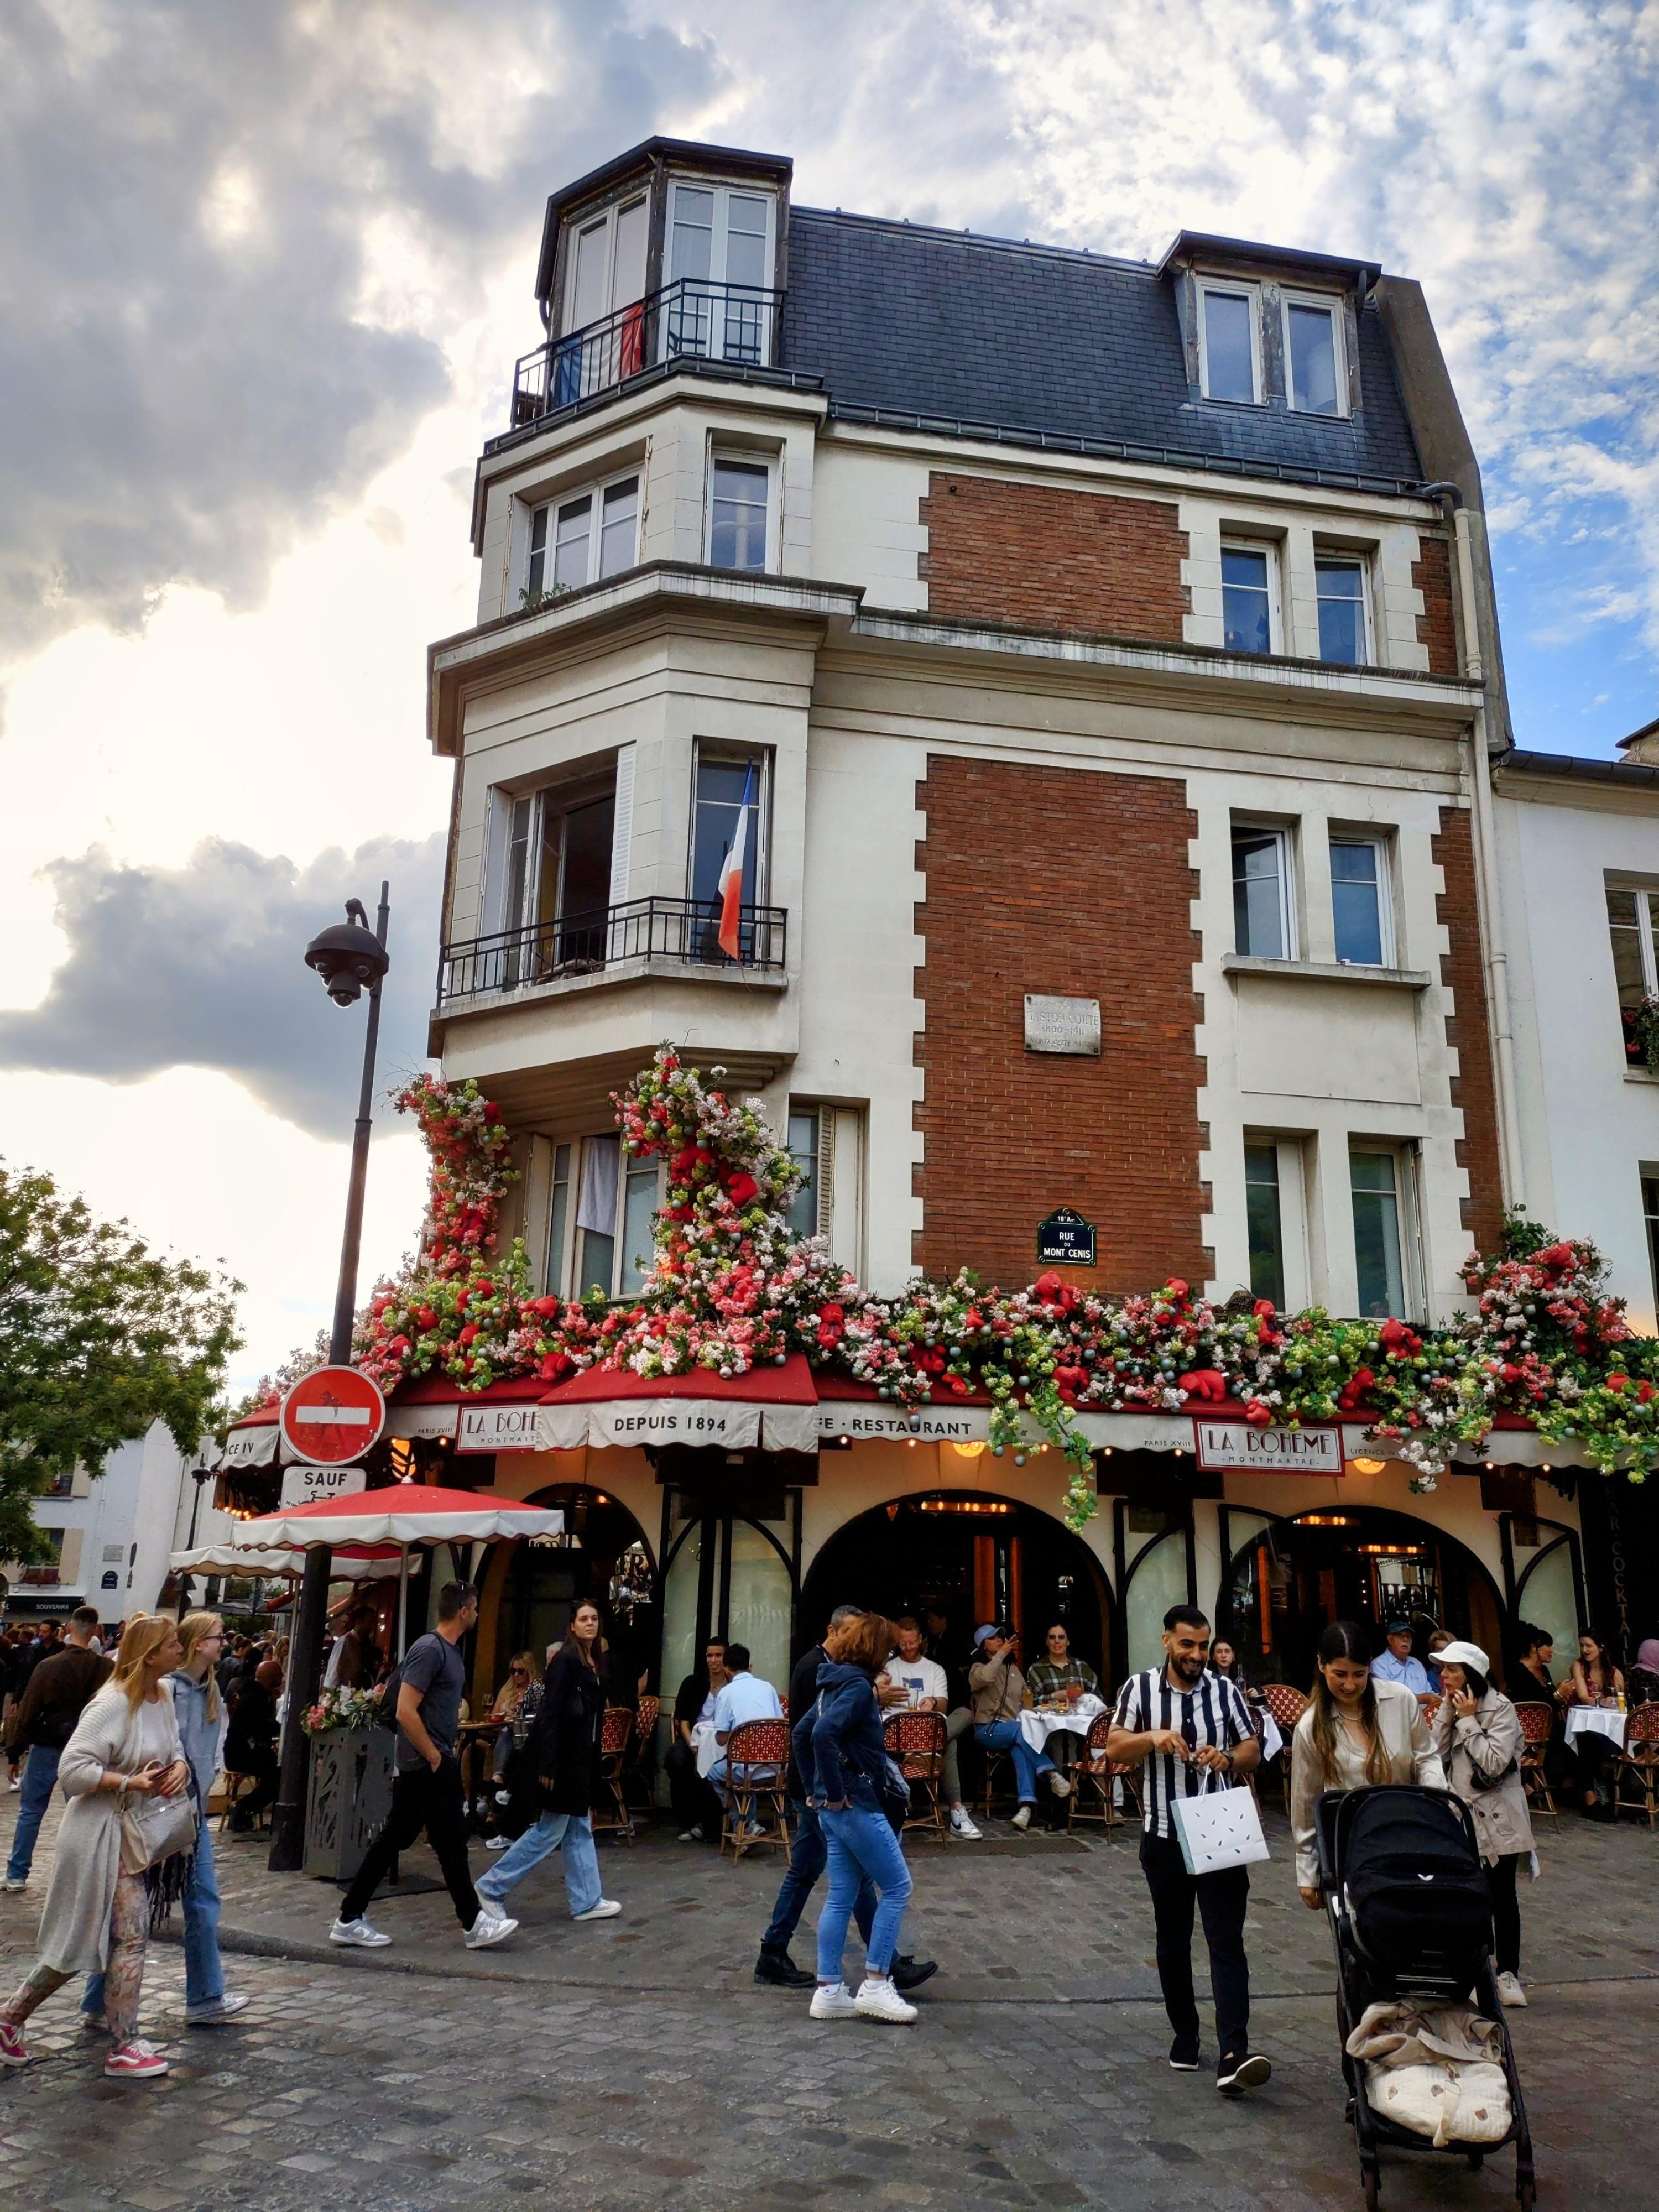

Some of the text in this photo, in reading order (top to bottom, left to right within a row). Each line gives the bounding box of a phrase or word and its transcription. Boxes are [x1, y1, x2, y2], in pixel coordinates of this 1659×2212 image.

[1059, 1232, 1075, 1241] RUE
[1044, 1248, 1091, 1258] MONT CENIS
[466, 1414, 486, 1434] LA
[614, 1416, 726, 1432] DEPUIS 1894
[852, 1418, 972, 1435] RESTAURANT
[242, 1442, 254, 1454] IV
[1208, 1430, 1332, 1455] LA BOHEME
[304, 1472, 348, 1486] SAUF
